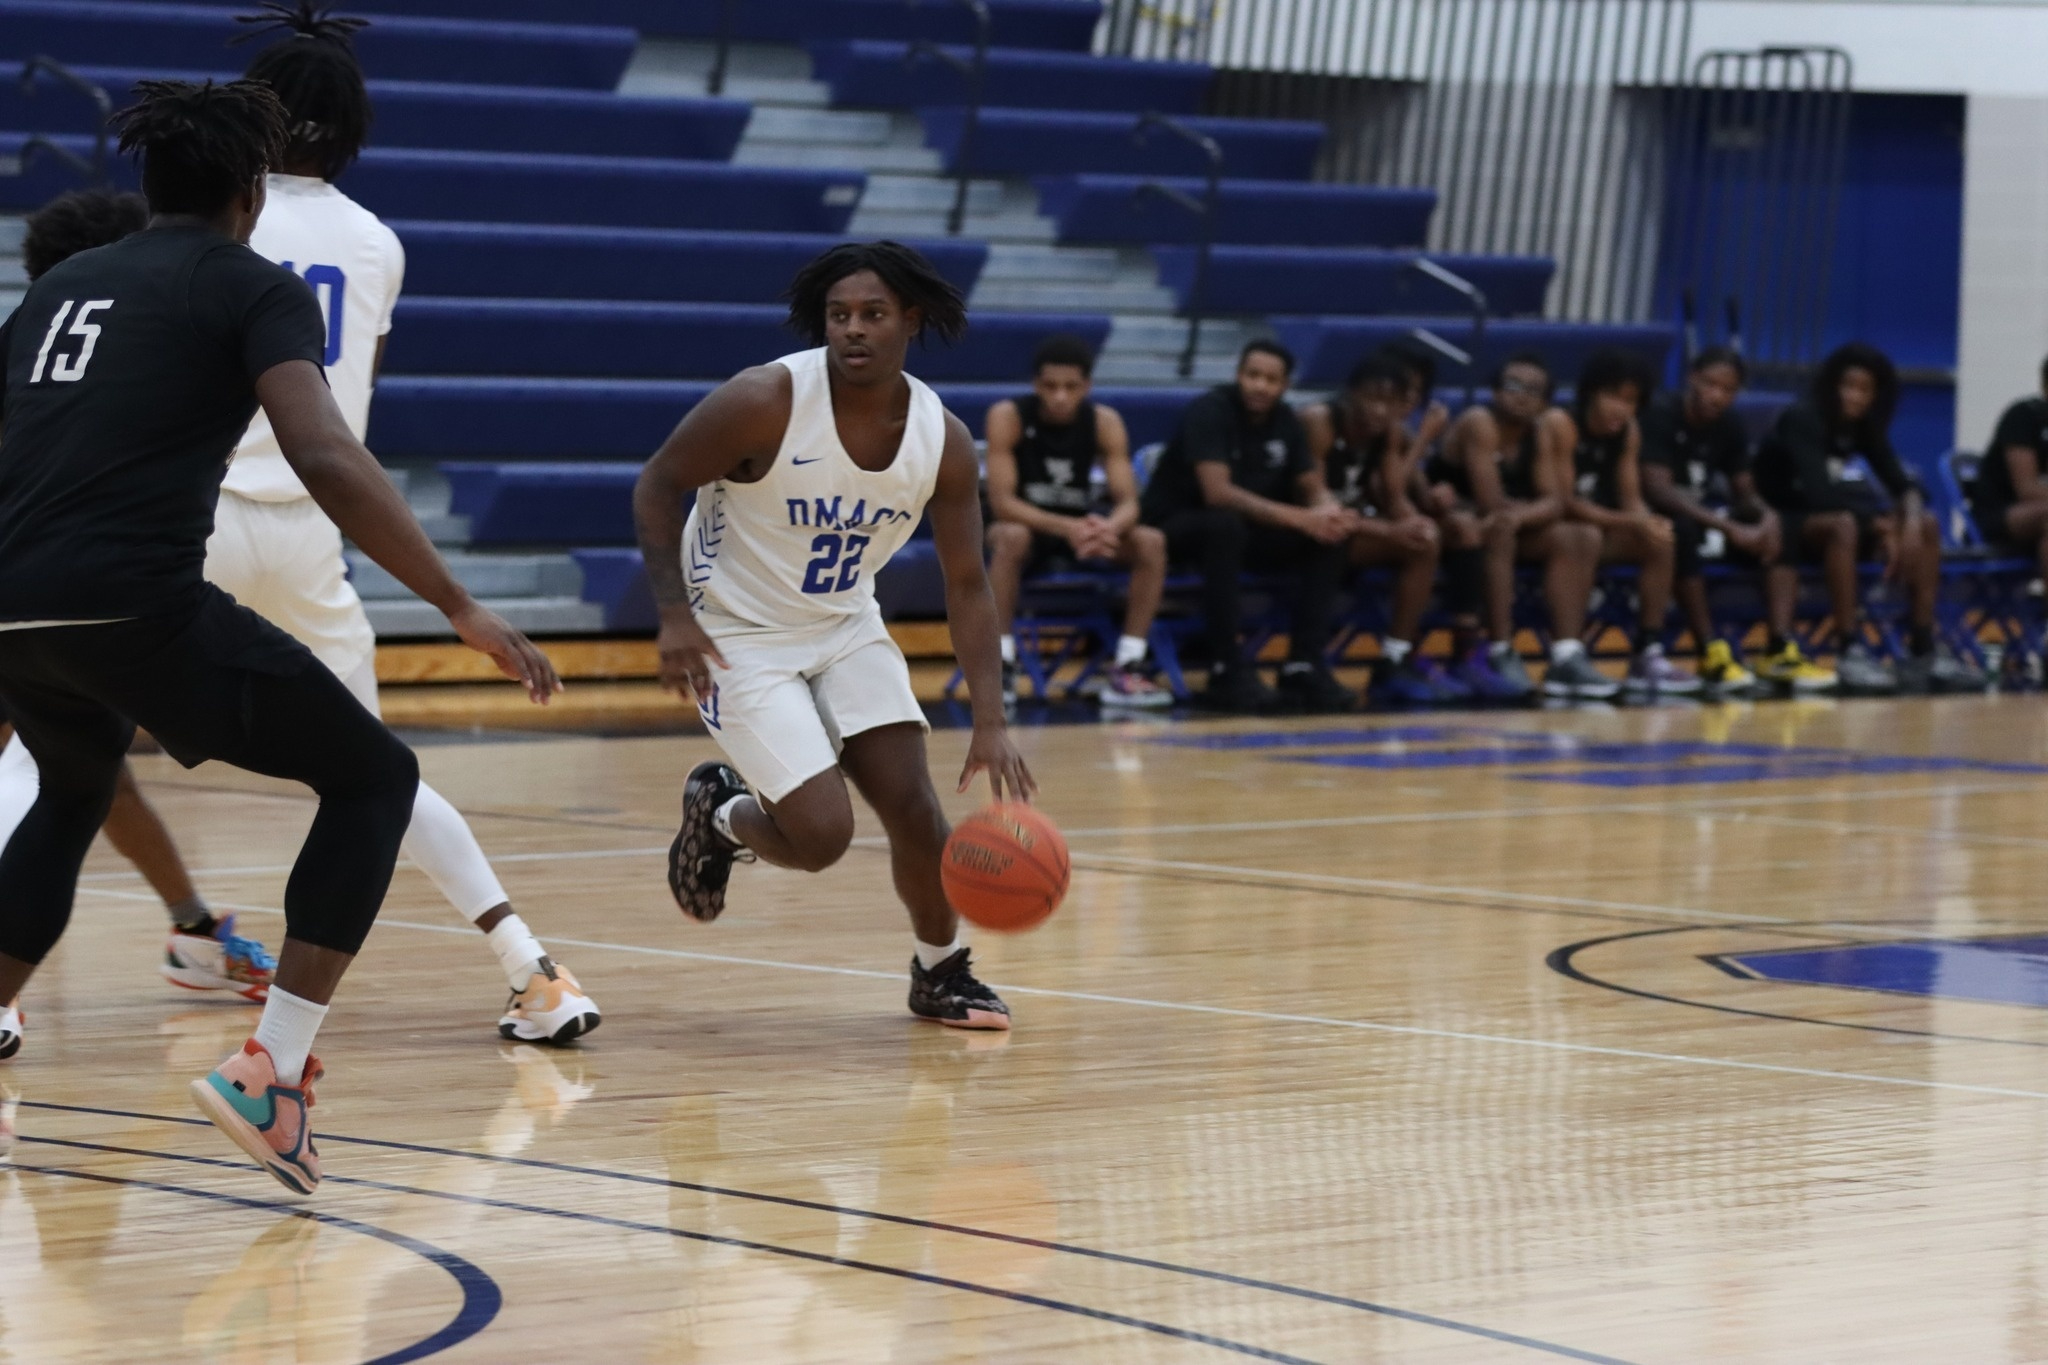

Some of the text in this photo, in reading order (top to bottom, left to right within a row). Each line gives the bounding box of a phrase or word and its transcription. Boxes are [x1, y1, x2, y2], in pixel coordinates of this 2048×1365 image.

[29, 299, 115, 383] 15
[281, 261, 346, 367] 0
[801, 533, 871, 594] 22
